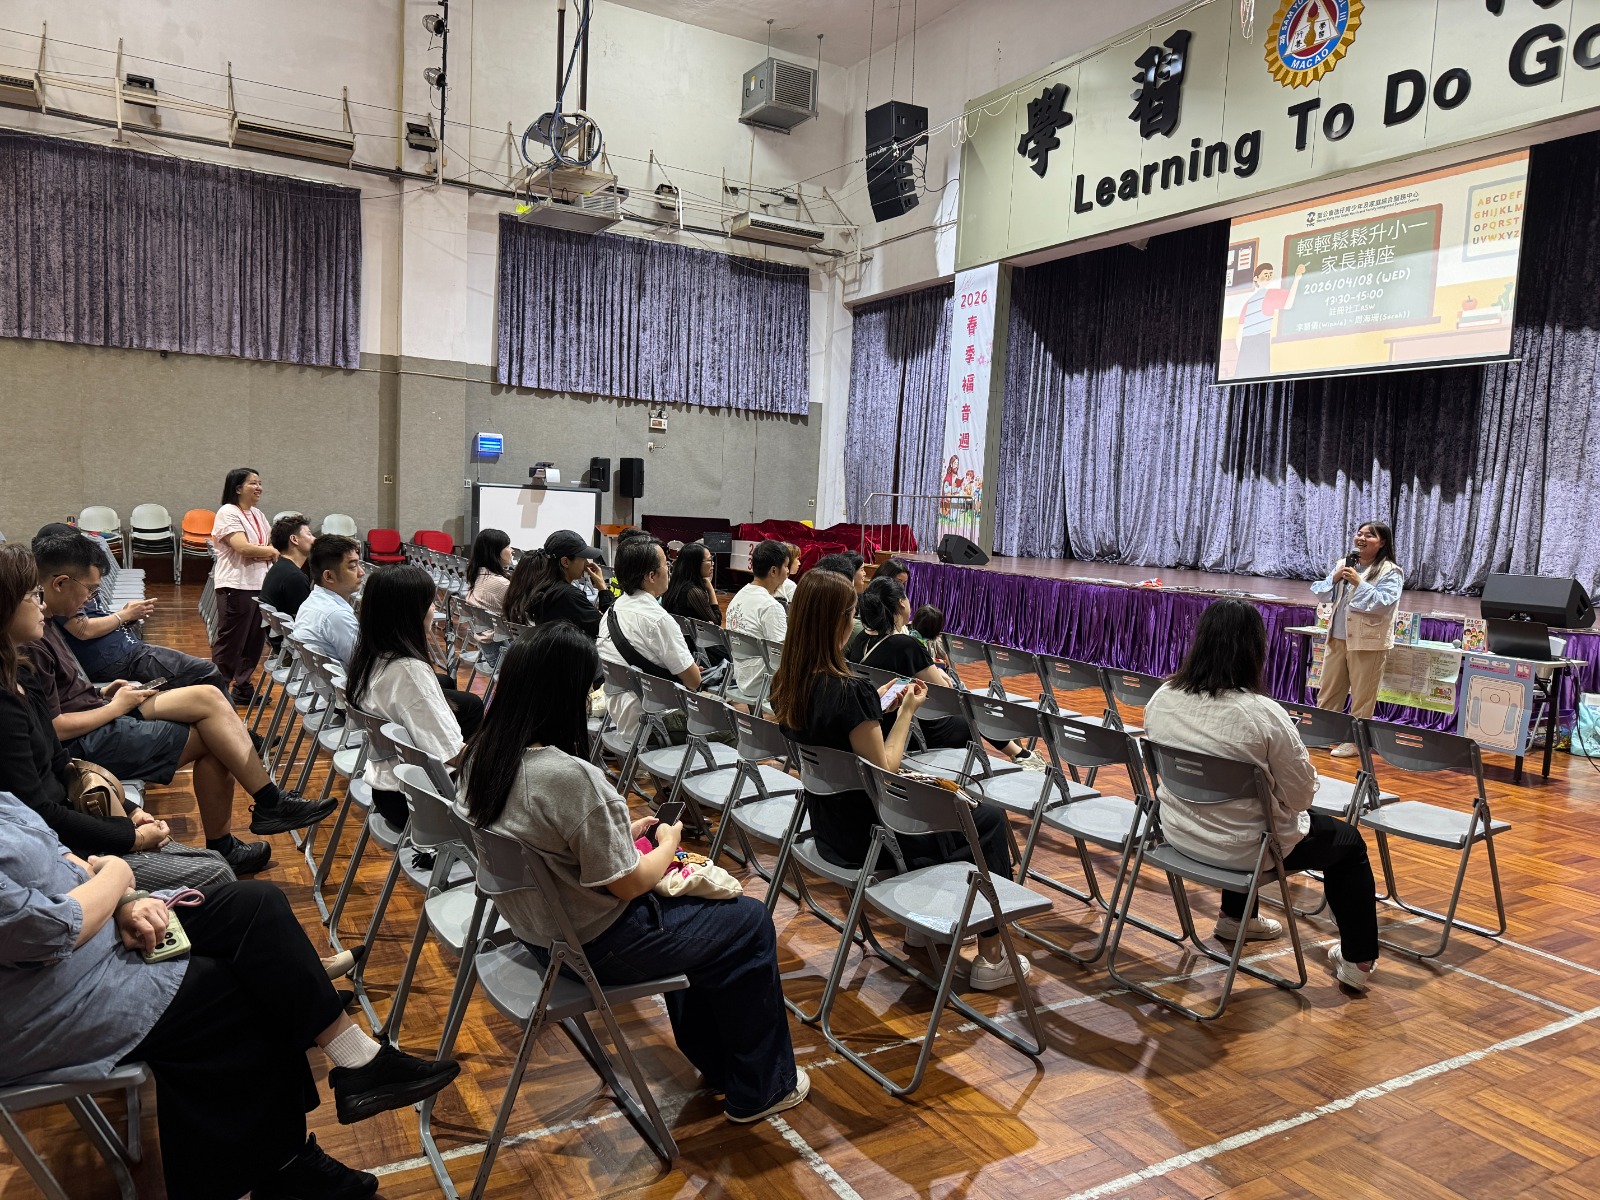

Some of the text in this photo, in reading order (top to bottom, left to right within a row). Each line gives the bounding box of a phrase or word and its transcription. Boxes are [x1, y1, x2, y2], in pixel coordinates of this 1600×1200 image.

[1282, 11, 1294, 31] SAM
[1291, 48, 1329, 69] MACAO
[1017, 29, 1192, 179] 學習
[1074, 129, 1262, 215] Learning
[1287, 97, 1355, 152] To
[1383, 68, 1472, 128] Do
[1296, 219, 1428, 258] 輕輕鬆鬆升小一
[1321, 244, 1396, 275] 家長講座
[1303, 267, 1411, 295] 2026/04/08 (WED)
[960, 290, 988, 309] 2026
[958, 315, 978, 451] 春季福音週
